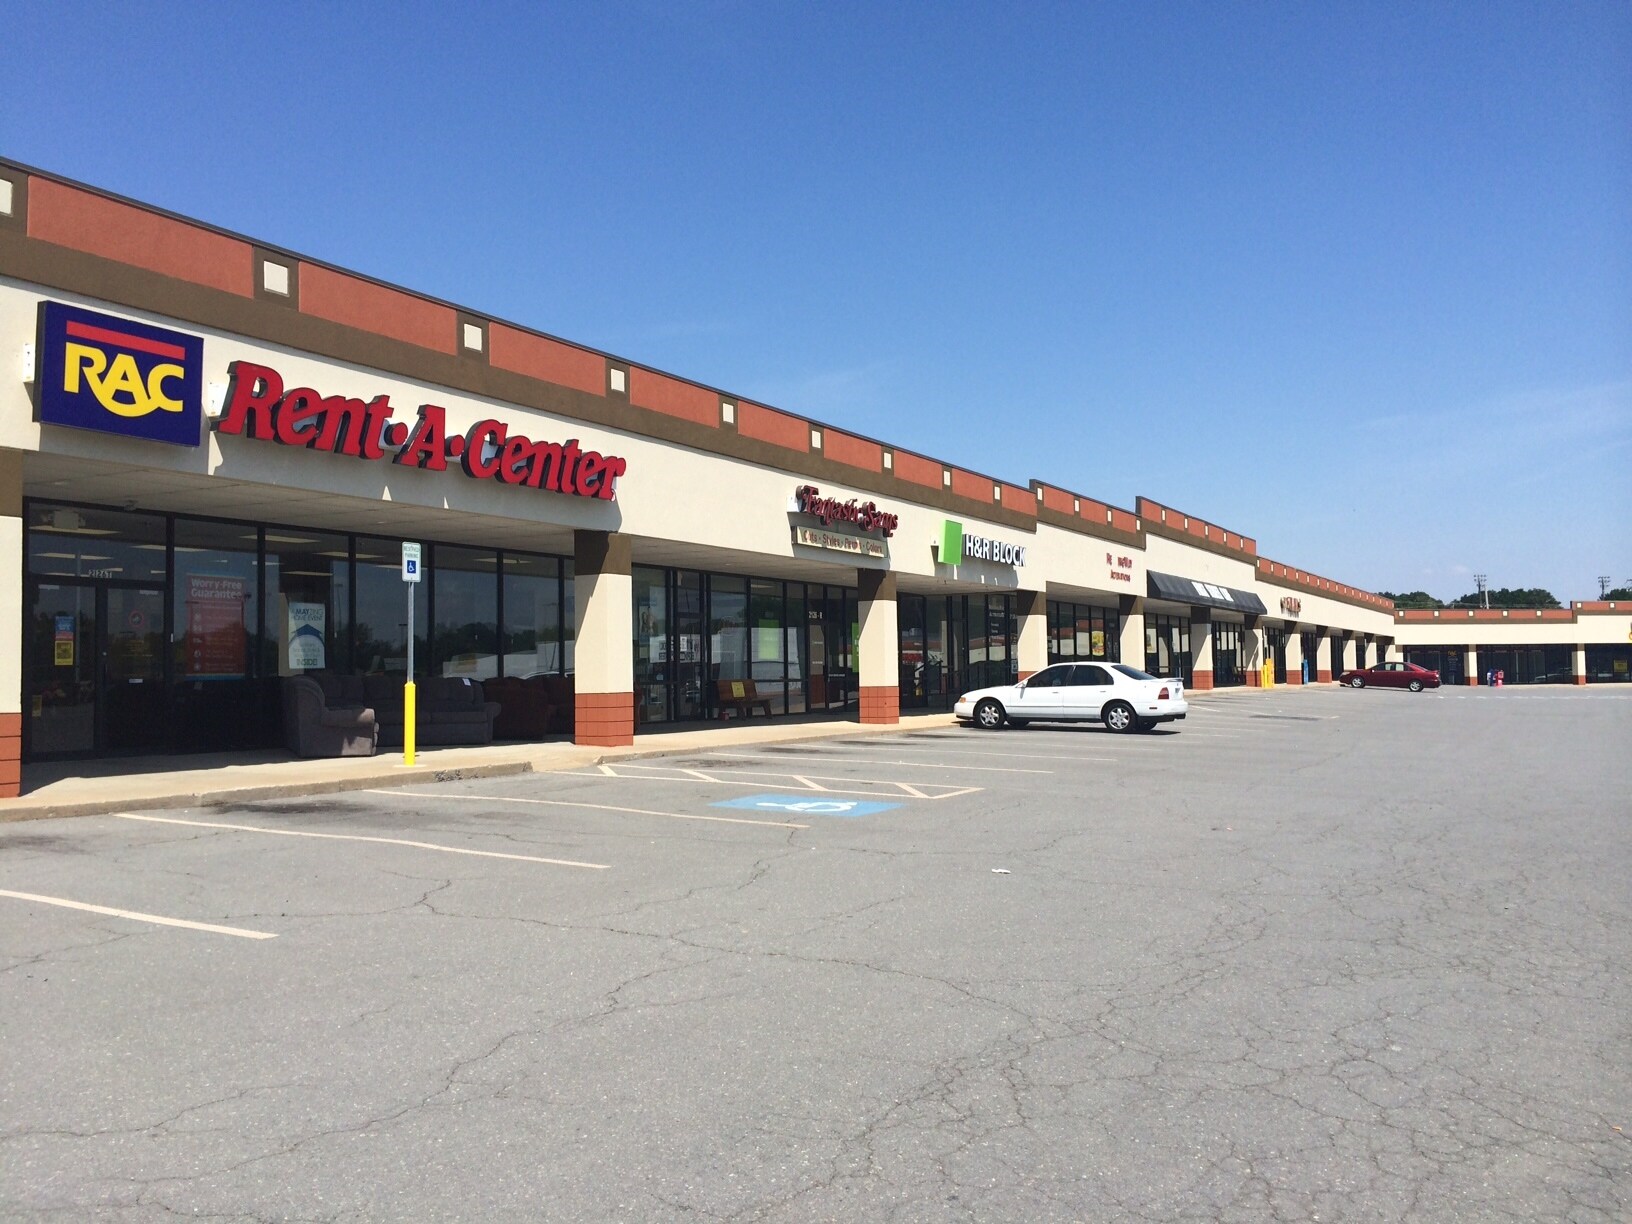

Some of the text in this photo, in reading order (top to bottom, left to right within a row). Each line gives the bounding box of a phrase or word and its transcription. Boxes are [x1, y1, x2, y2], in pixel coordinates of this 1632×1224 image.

[64, 341, 185, 418] RAC
[798, 485, 899, 537] Fantastic Sams
[965, 534, 1026, 567] H&R BLOCK
[191, 578, 242, 590] Worry-Free
[191, 588, 242, 600] Guarantee
